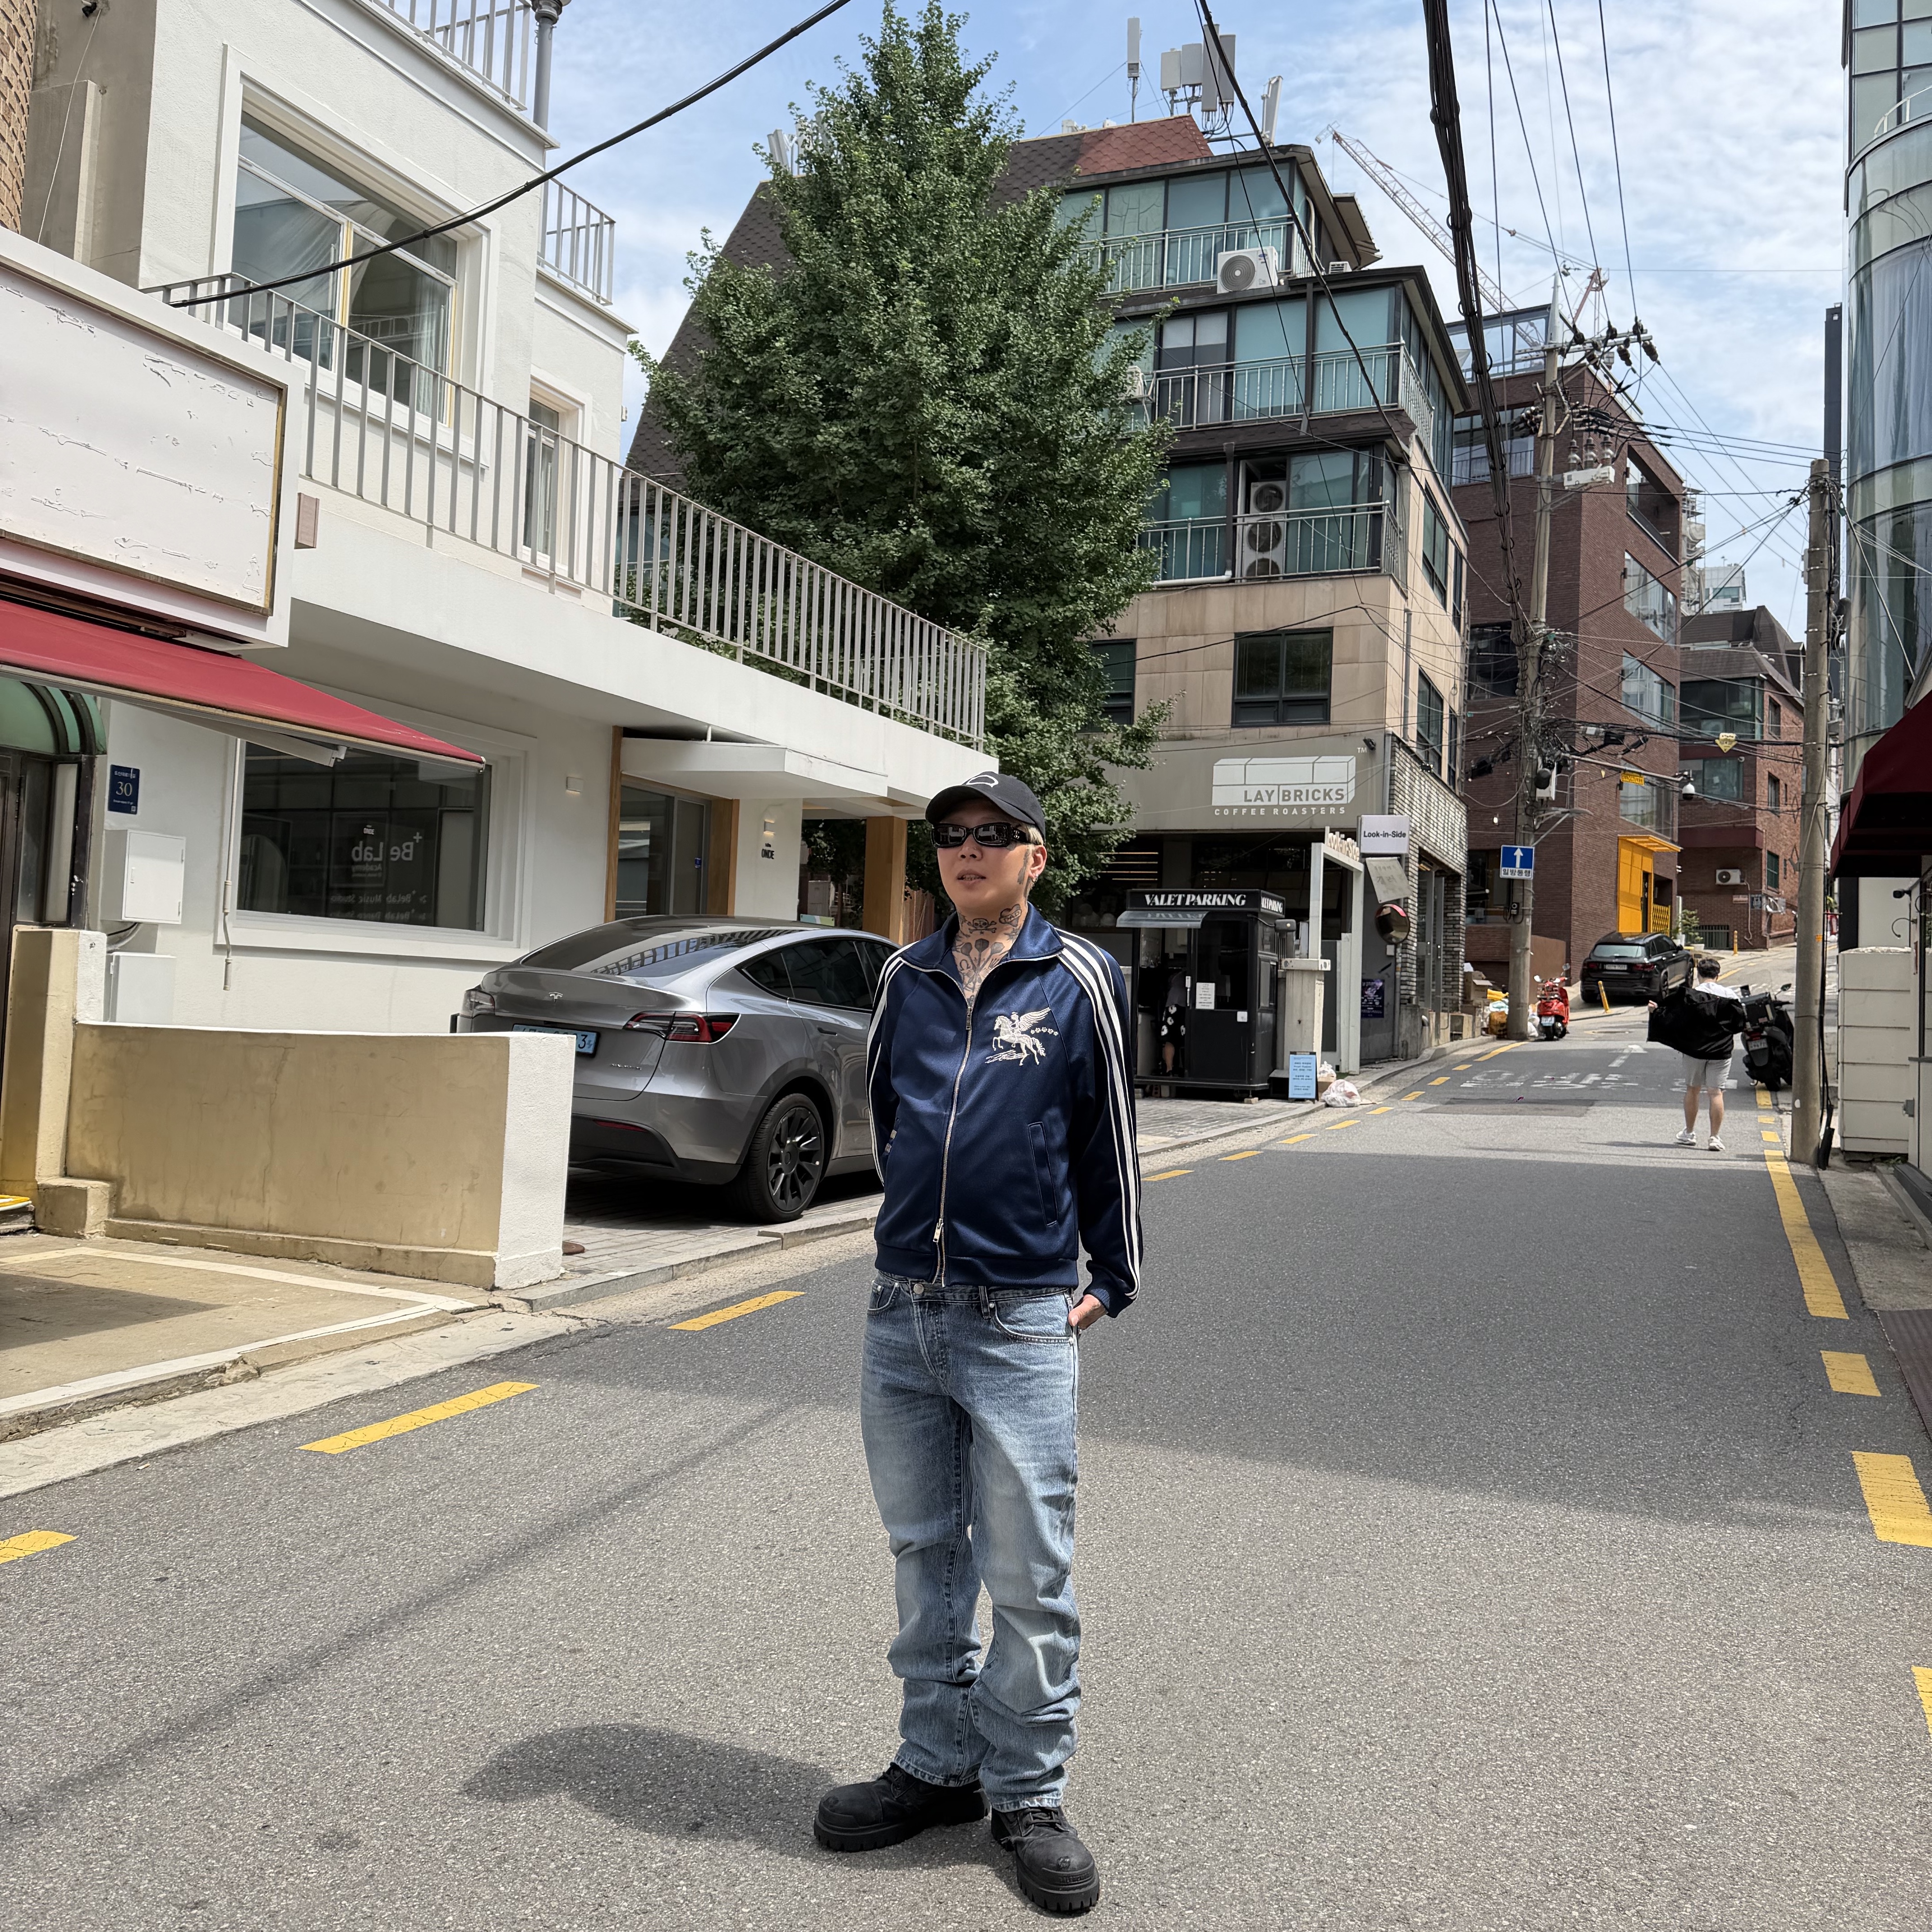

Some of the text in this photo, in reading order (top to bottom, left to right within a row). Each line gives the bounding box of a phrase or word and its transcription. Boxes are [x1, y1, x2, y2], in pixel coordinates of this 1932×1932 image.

[116, 781, 132, 796] 30
[1244, 788, 1344, 802] LAY BRICKS
[1503, 868, 1531, 877] 일방통행
[1145, 894, 1246, 906] VALET PARKING
[1004, 911, 1020, 922] DAD
